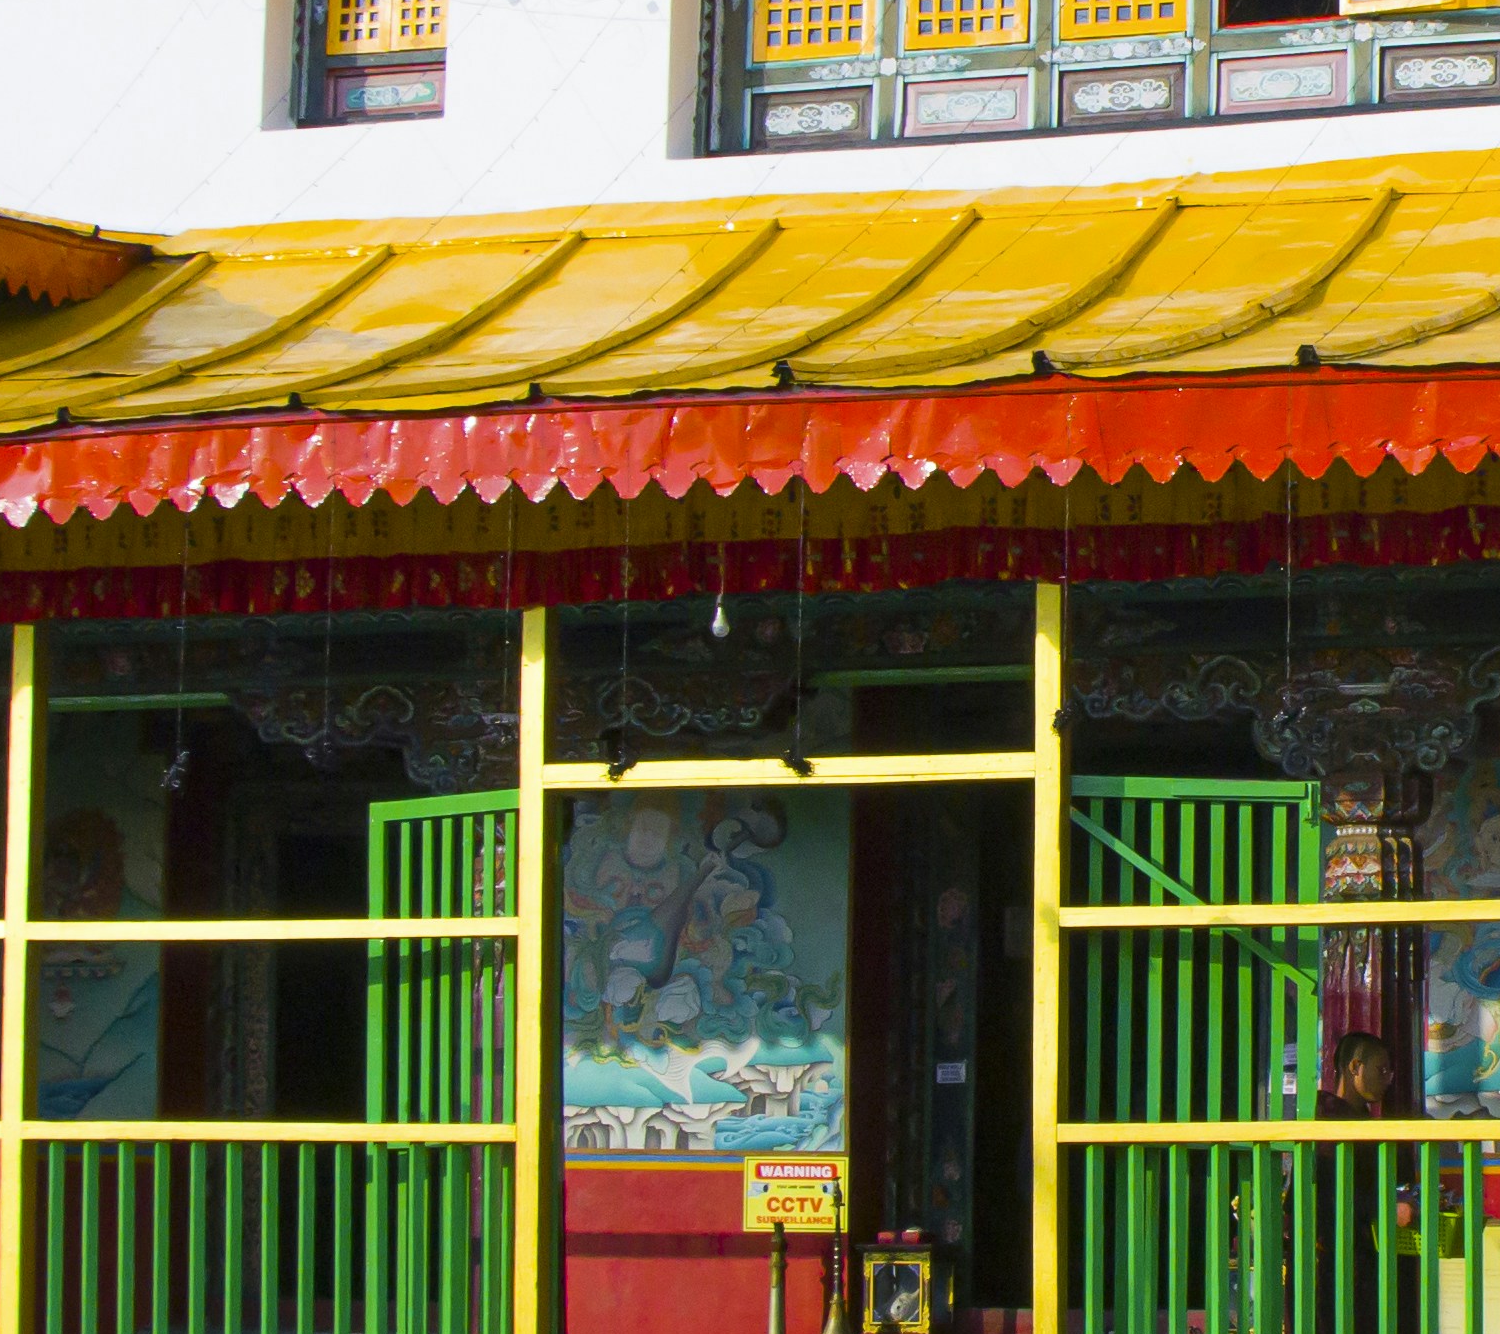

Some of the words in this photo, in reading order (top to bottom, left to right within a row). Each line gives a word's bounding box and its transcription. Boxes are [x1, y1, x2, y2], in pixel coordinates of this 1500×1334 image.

[760, 1165, 833, 1178] WARNING
[766, 1196, 823, 1213] CCTV
[756, 1215, 834, 1225] SURVEILLANCE
